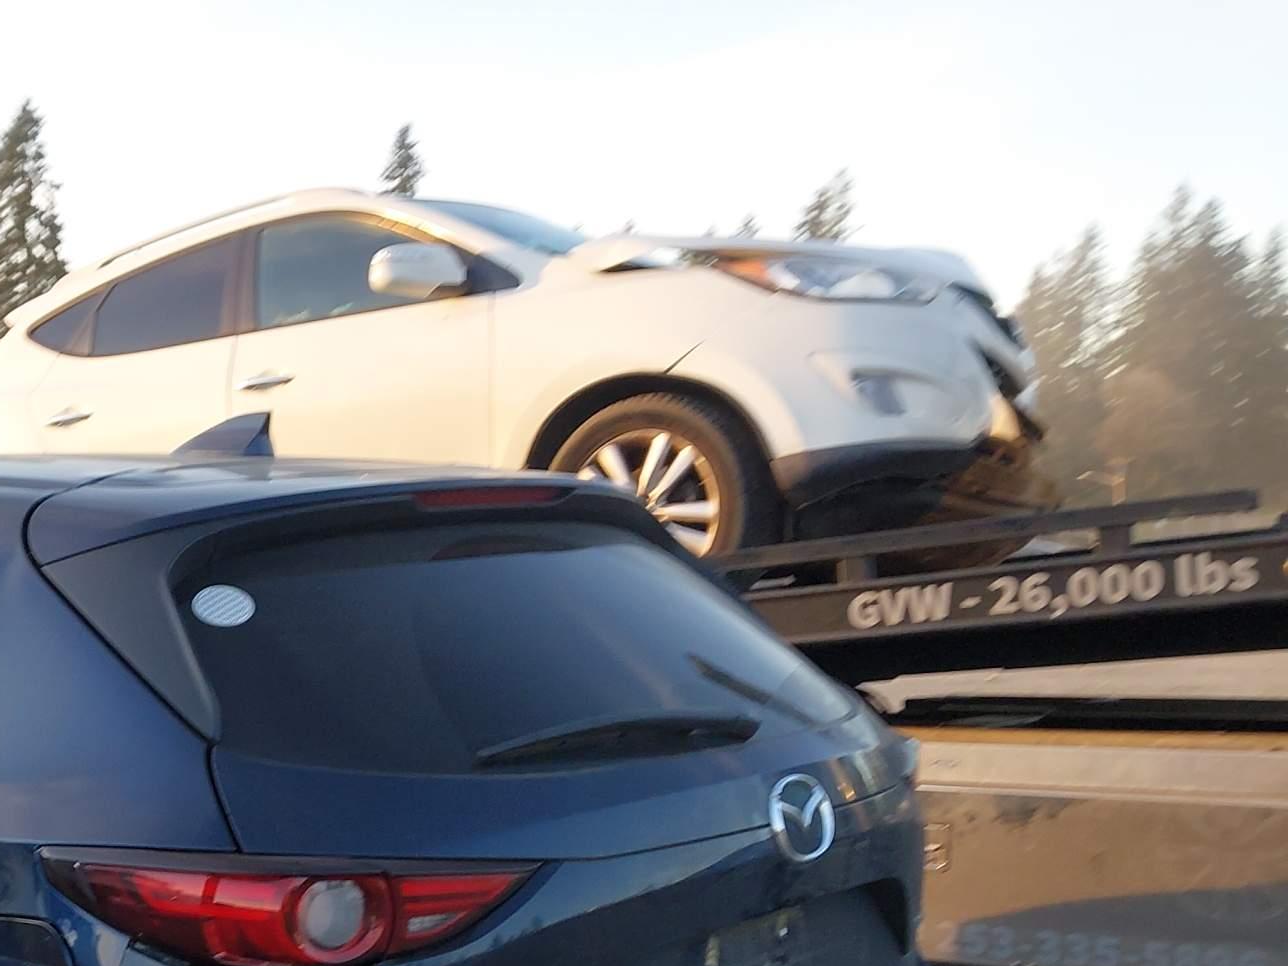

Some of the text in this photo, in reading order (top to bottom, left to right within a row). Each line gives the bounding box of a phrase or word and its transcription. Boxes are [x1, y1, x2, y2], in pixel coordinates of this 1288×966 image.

[846, 581, 955, 630] GVW
[987, 560, 1168, 620] 26,000
[1175, 551, 1262, 599] lbs
